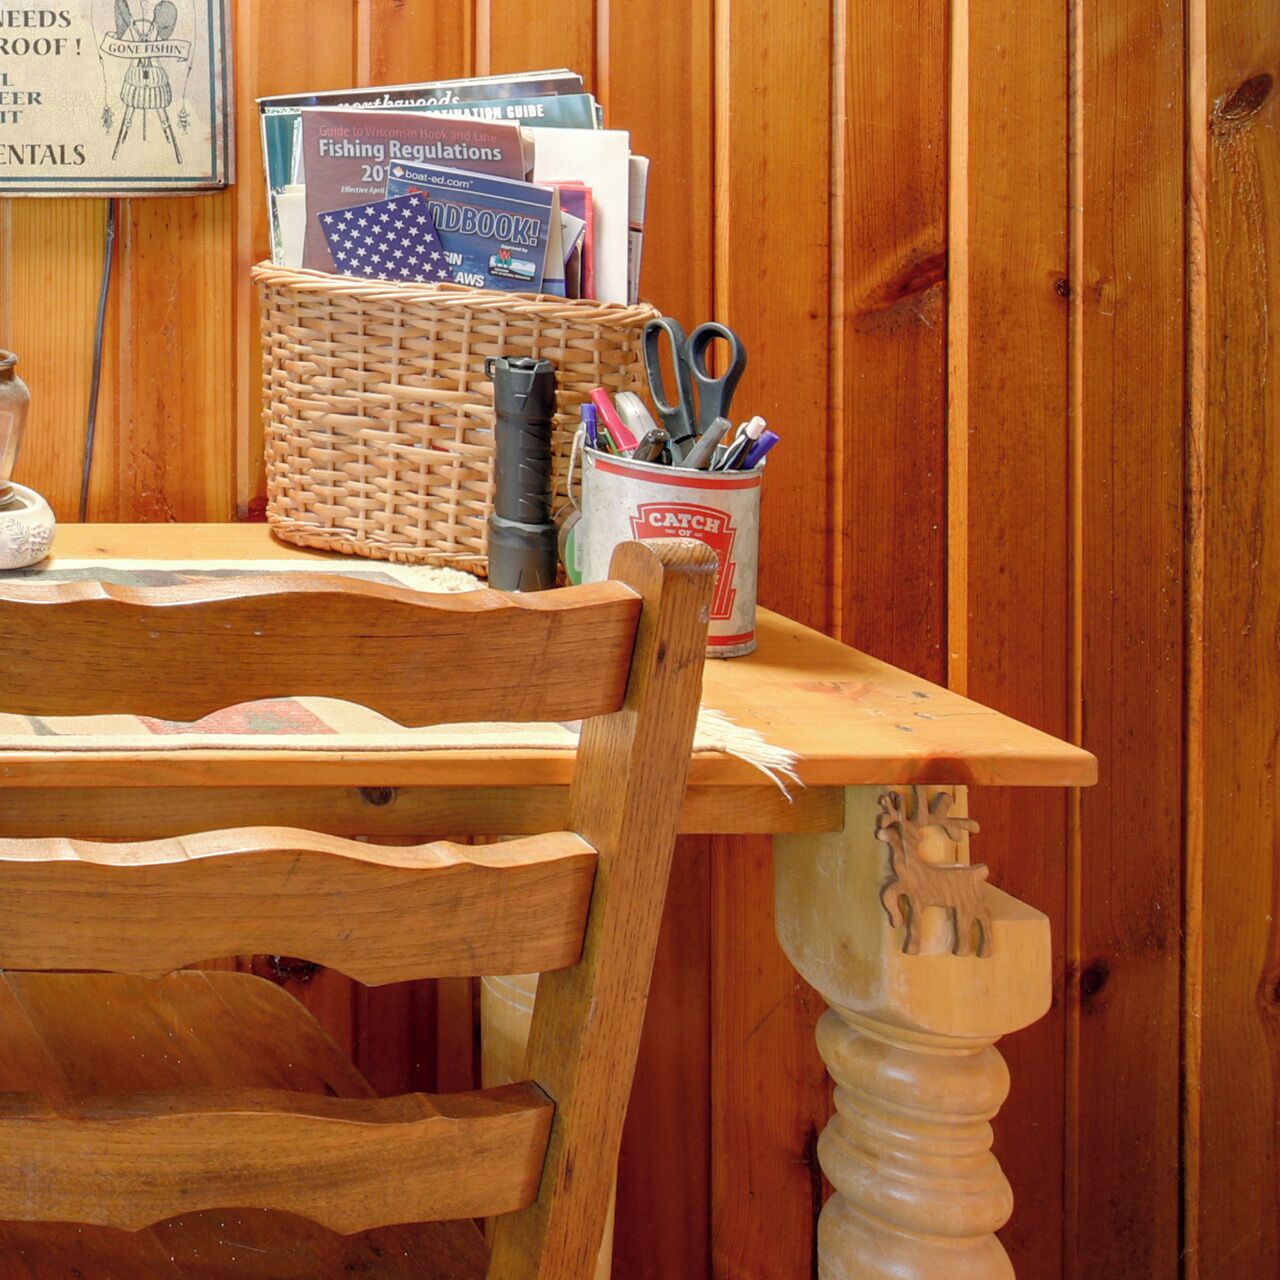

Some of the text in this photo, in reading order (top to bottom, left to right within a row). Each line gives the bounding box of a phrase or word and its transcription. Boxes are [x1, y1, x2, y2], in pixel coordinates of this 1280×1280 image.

[108, 42, 141, 54] GONE
[506, 104, 544, 119] GUIDE
[320, 125, 498, 142] Guide to Wisconsin Hook and Line
[319, 139, 502, 161] Fishing Regulations
[341, 185, 385, 195] Effective April
[648, 511, 721, 533] CATCH
